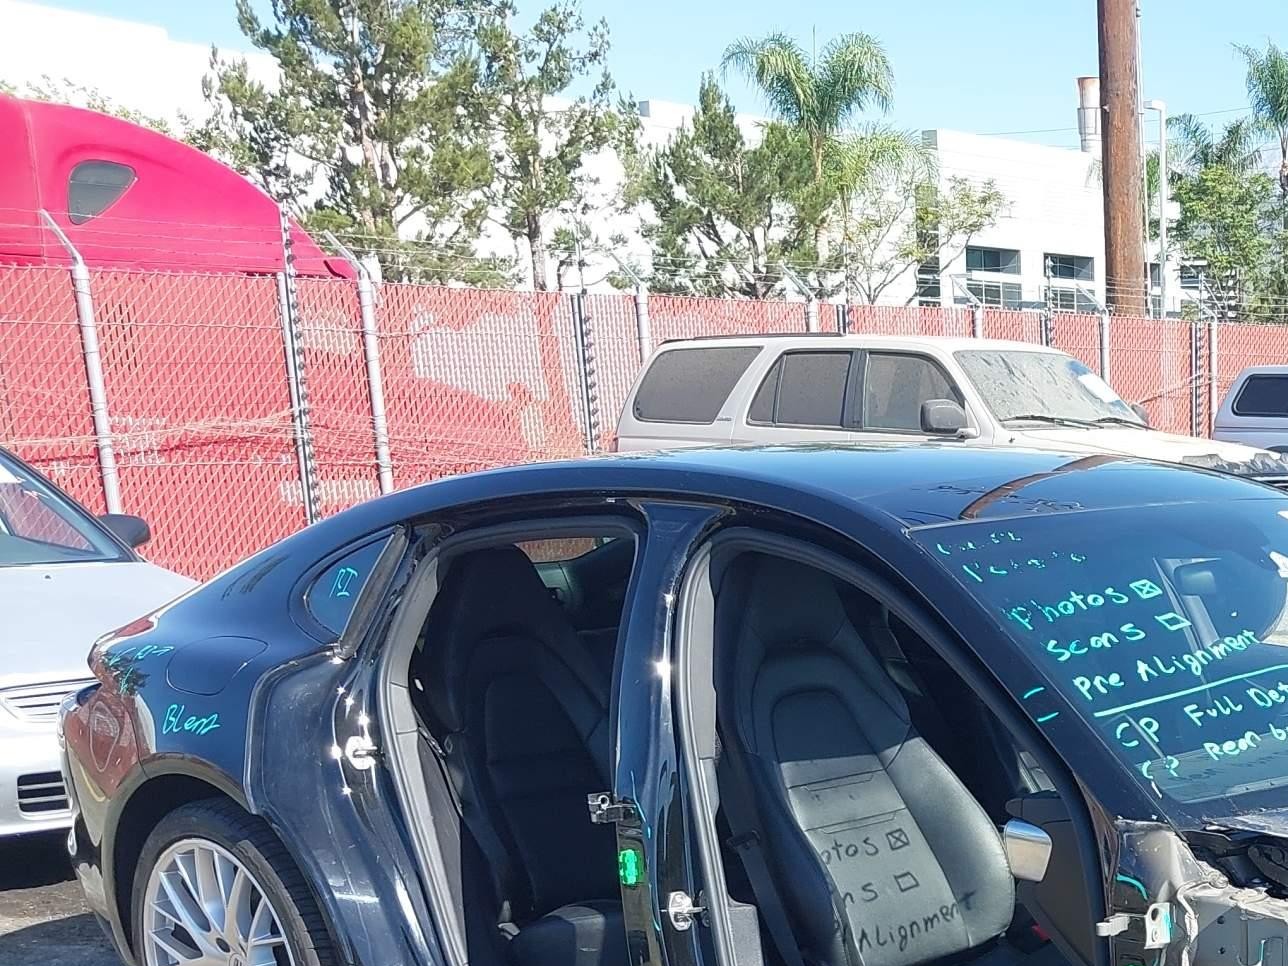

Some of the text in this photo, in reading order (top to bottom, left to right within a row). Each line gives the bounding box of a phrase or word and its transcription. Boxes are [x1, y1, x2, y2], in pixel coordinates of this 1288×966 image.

[1004, 587, 1129, 630] Photos
[1046, 623, 1146, 661] Scans
[1073, 672, 1125, 700] Pre
